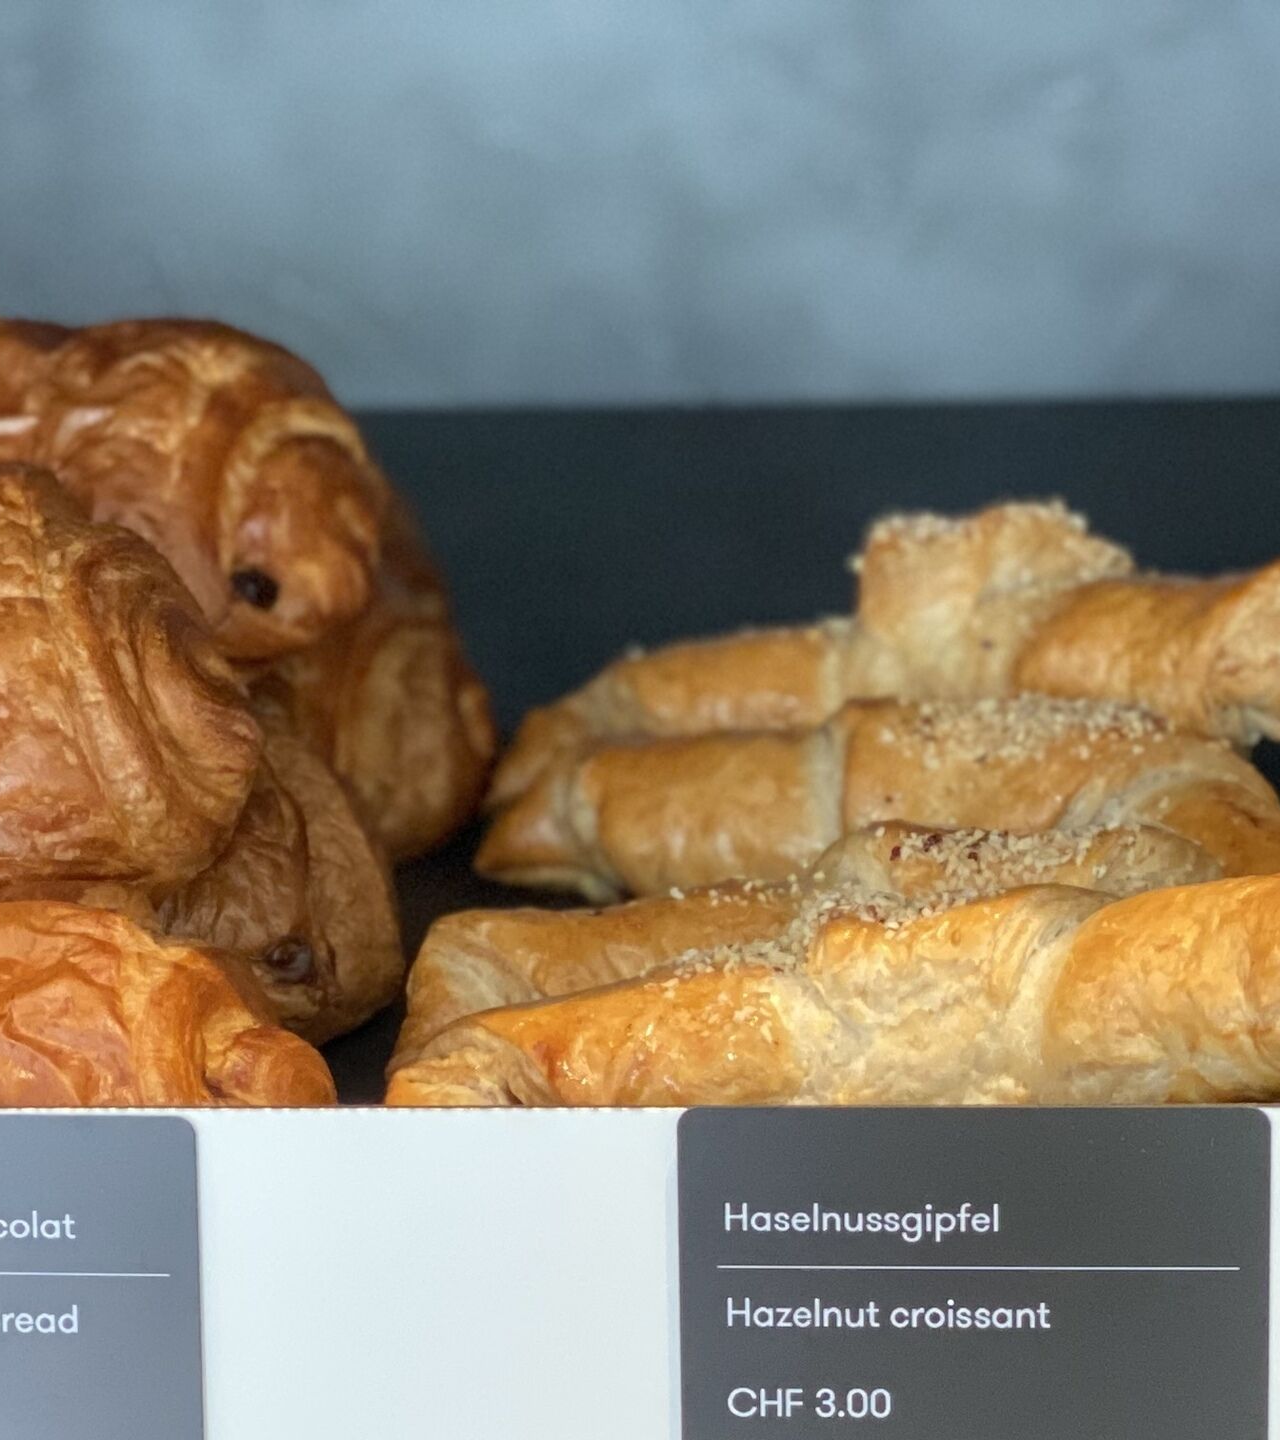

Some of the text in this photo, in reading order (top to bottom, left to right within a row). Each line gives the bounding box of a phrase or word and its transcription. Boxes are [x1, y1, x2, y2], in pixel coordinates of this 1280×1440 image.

[724, 1202, 999, 1243] Haselnussgipfel
[726, 1296, 1052, 1329] Hazelnut croissant
[727, 1387, 892, 1419] CHF 3.00
